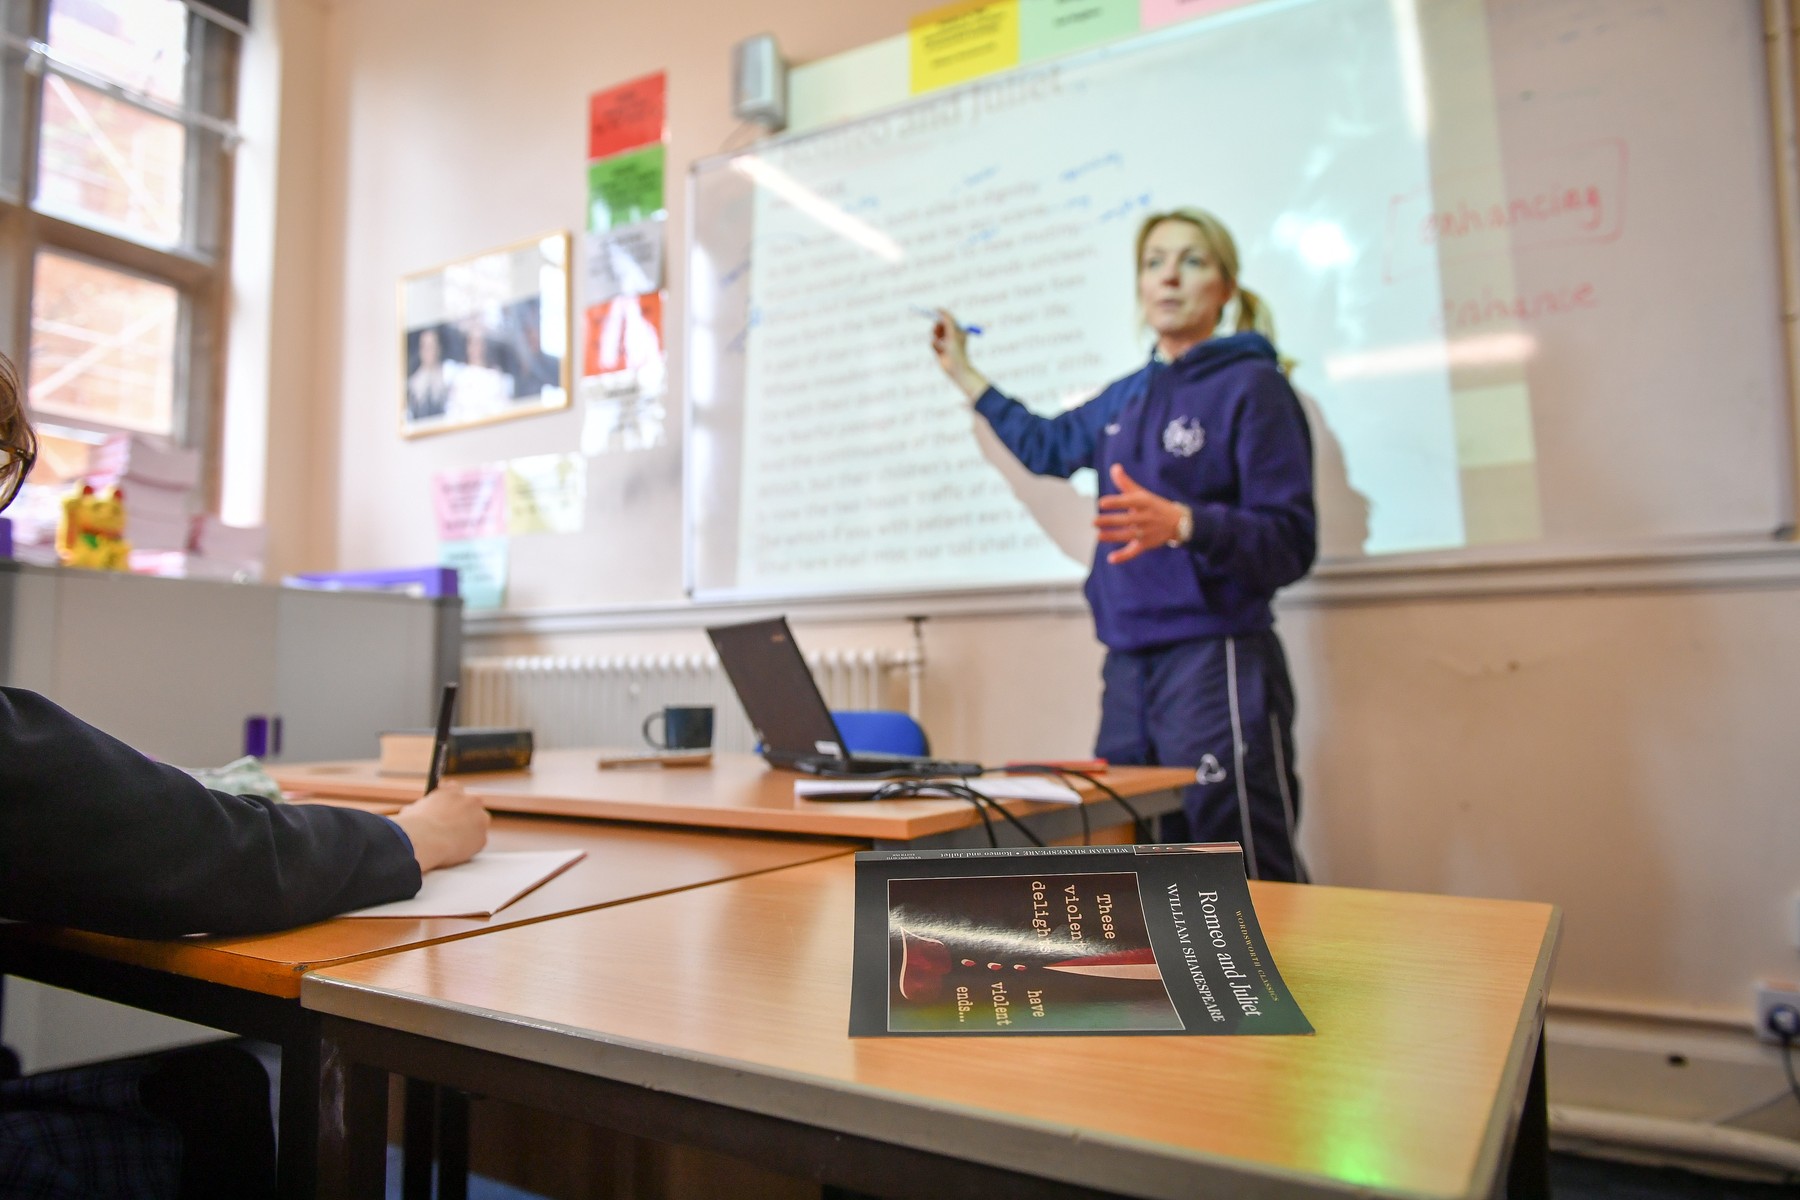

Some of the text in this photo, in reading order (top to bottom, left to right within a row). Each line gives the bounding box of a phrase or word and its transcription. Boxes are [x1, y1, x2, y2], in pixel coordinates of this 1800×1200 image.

[1096, 893, 1116, 940] These
[1166, 882, 1226, 1023] WILLIAM SHAKESPEARE
[1198, 890, 1262, 1017] Romeo and Juliet
[1236, 910, 1279, 1002] WORDSWORTH CLASSICS
[956, 985, 973, 1023] ends...
[991, 981, 1012, 1026] violent
[1027, 989, 1045, 1018] have
